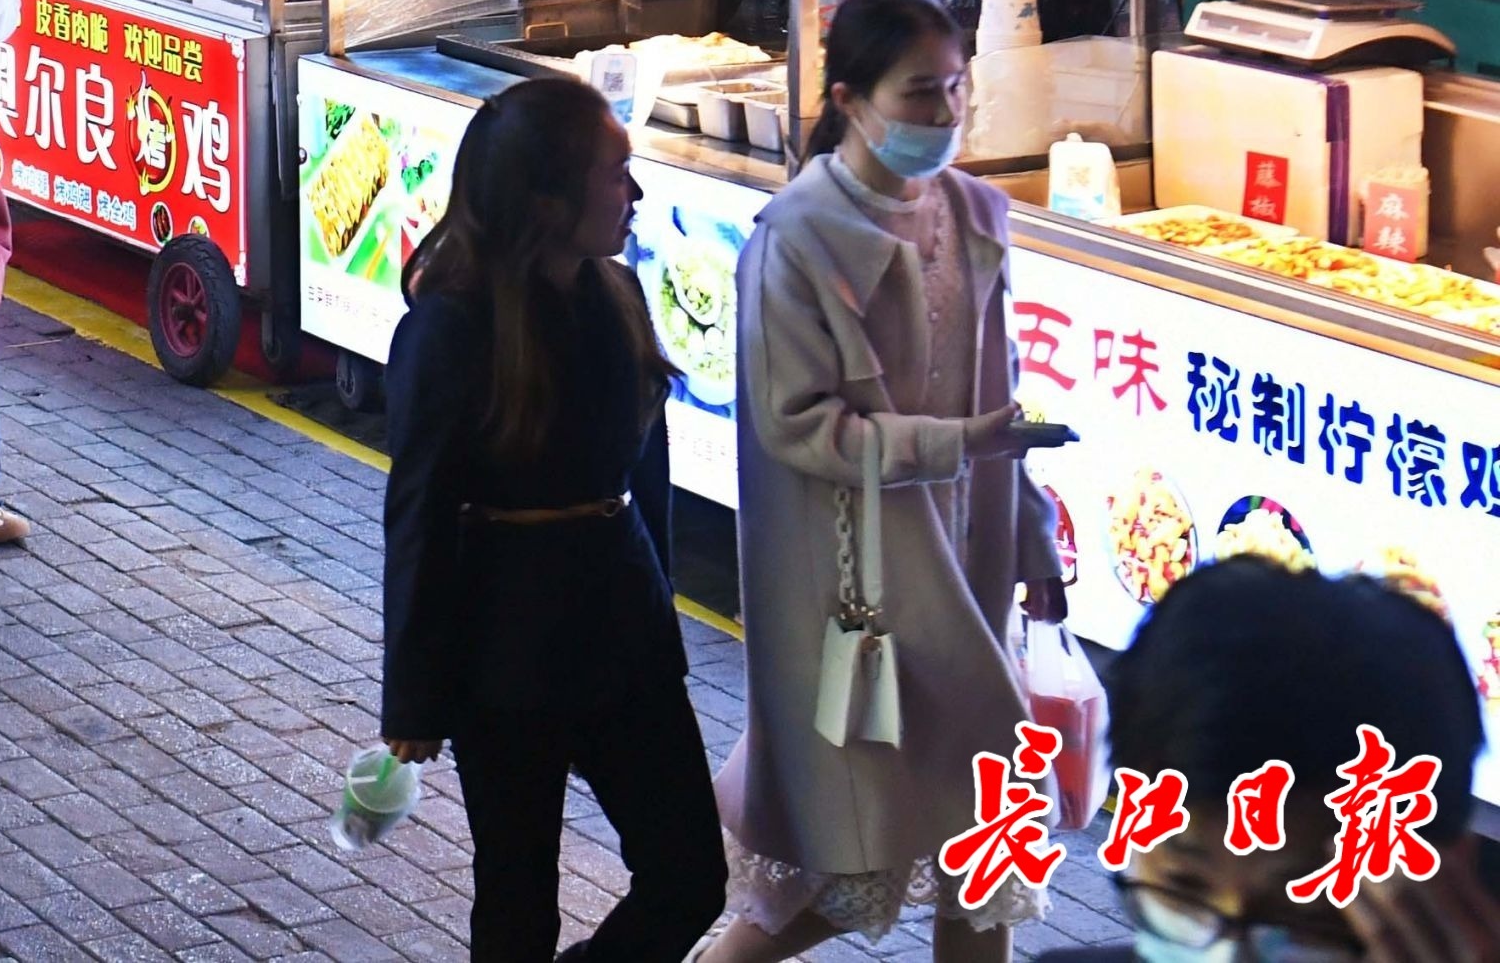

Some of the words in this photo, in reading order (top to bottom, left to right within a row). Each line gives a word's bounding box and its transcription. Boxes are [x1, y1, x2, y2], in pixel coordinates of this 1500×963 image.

[123, 22, 203, 83] 欢迎品尝
[96, 189, 138, 231] 烤全鸡
[1373, 192, 1410, 255] 麻辣
